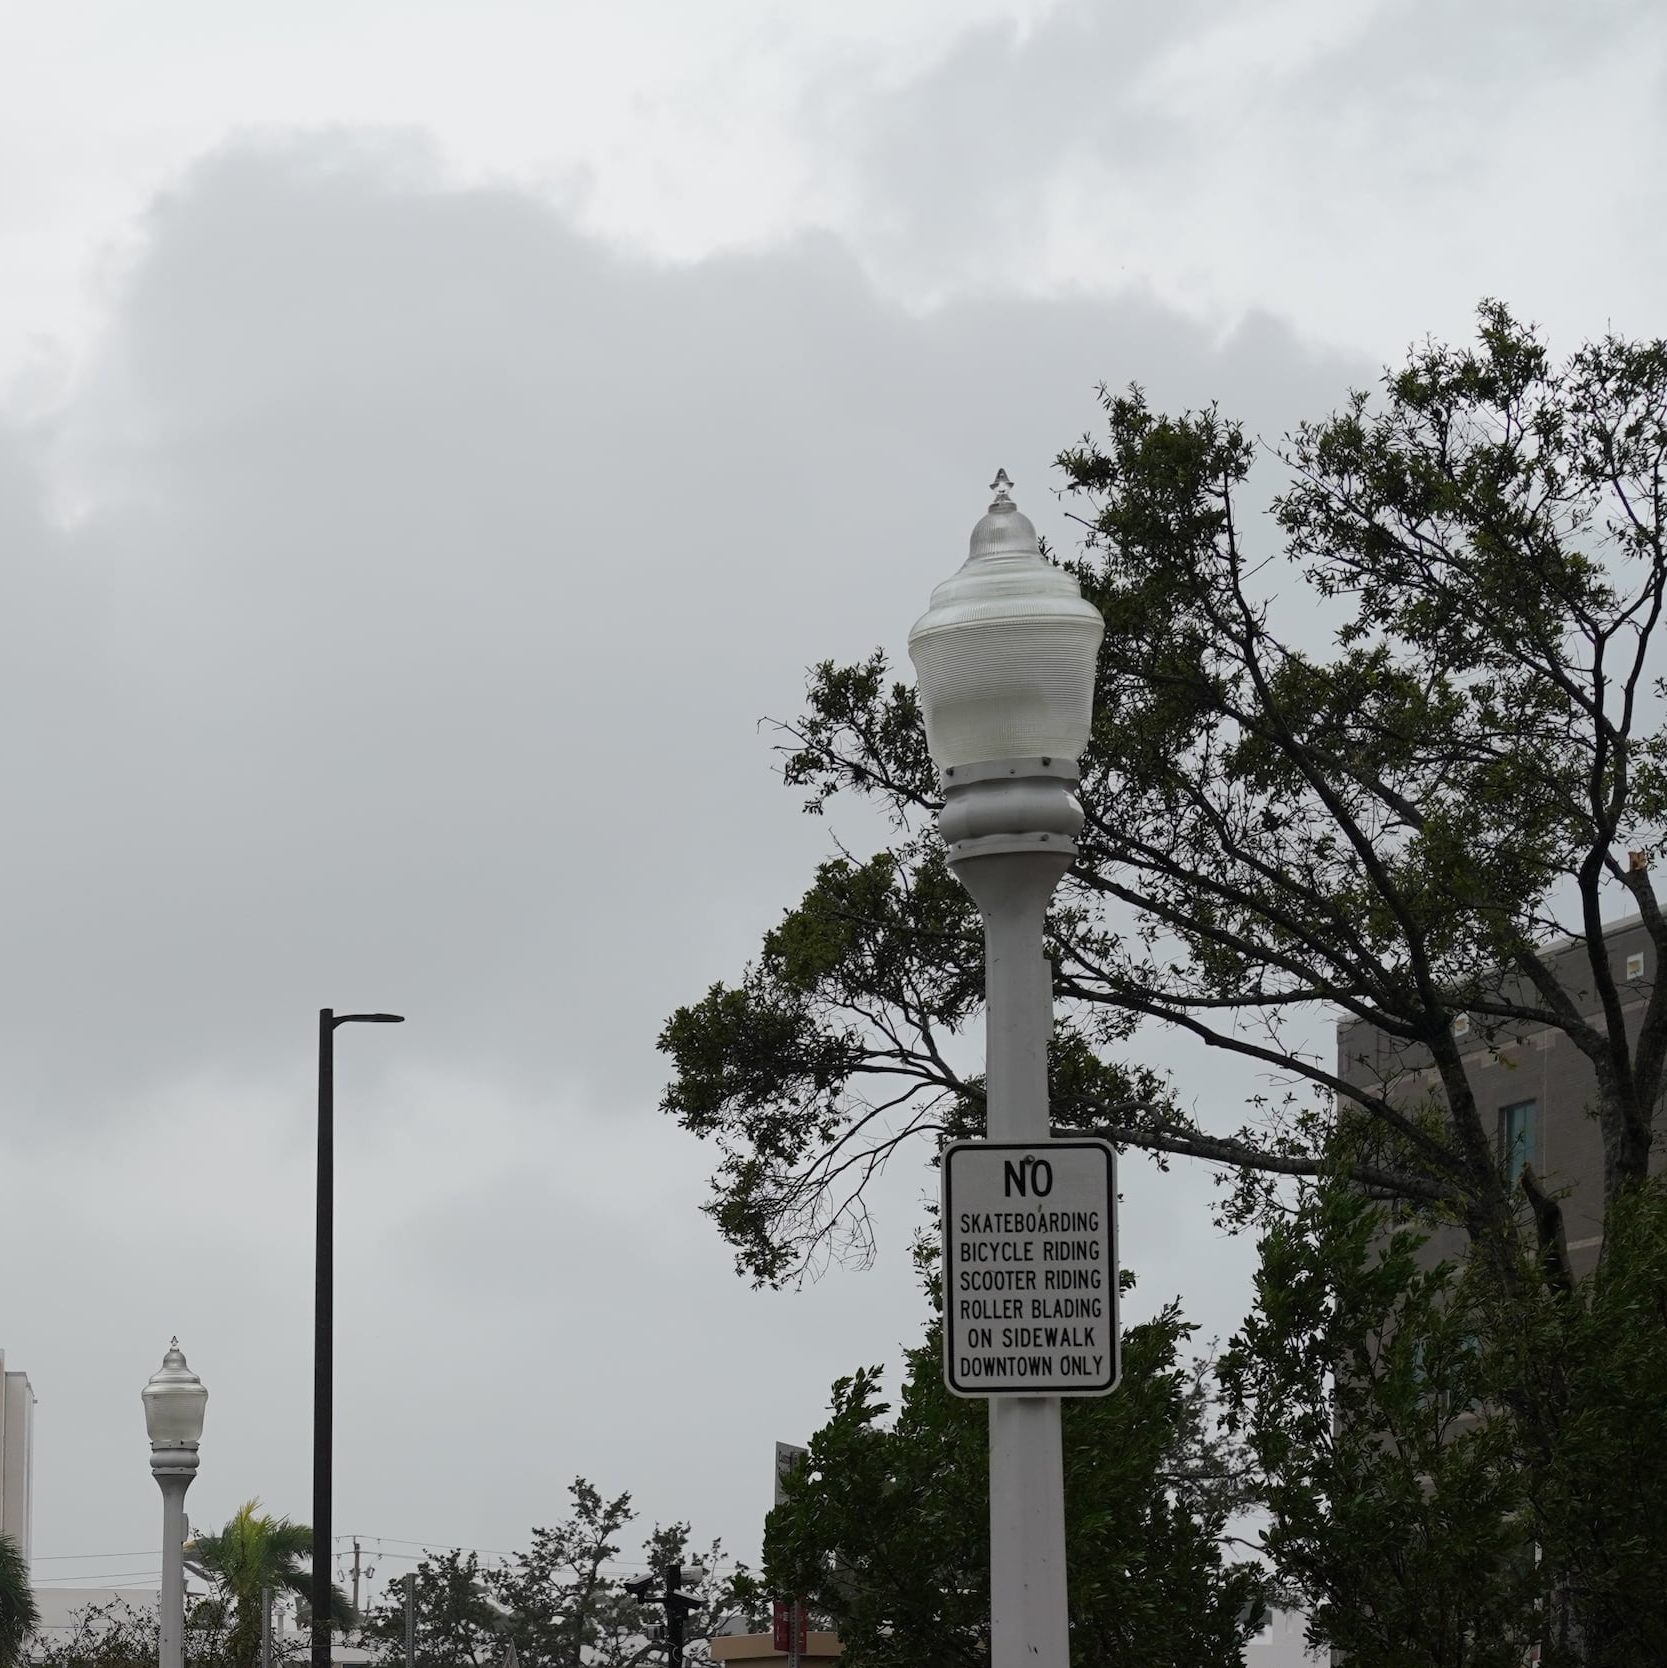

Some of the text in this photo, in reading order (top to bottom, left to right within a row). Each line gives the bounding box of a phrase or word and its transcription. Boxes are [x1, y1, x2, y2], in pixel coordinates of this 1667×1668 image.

[1004, 1160, 1053, 1198] NO
[960, 1212, 1099, 1234] SKATEBOARDING
[960, 1240, 1100, 1263] BICYCLE RIDING
[960, 1269, 1101, 1291] SCOOTER RIDING
[960, 1298, 1102, 1320] ROLLER BLADING
[968, 1327, 1095, 1348] ON SIDEWALK
[960, 1355, 1103, 1377] DOWNTOWN ONLY
